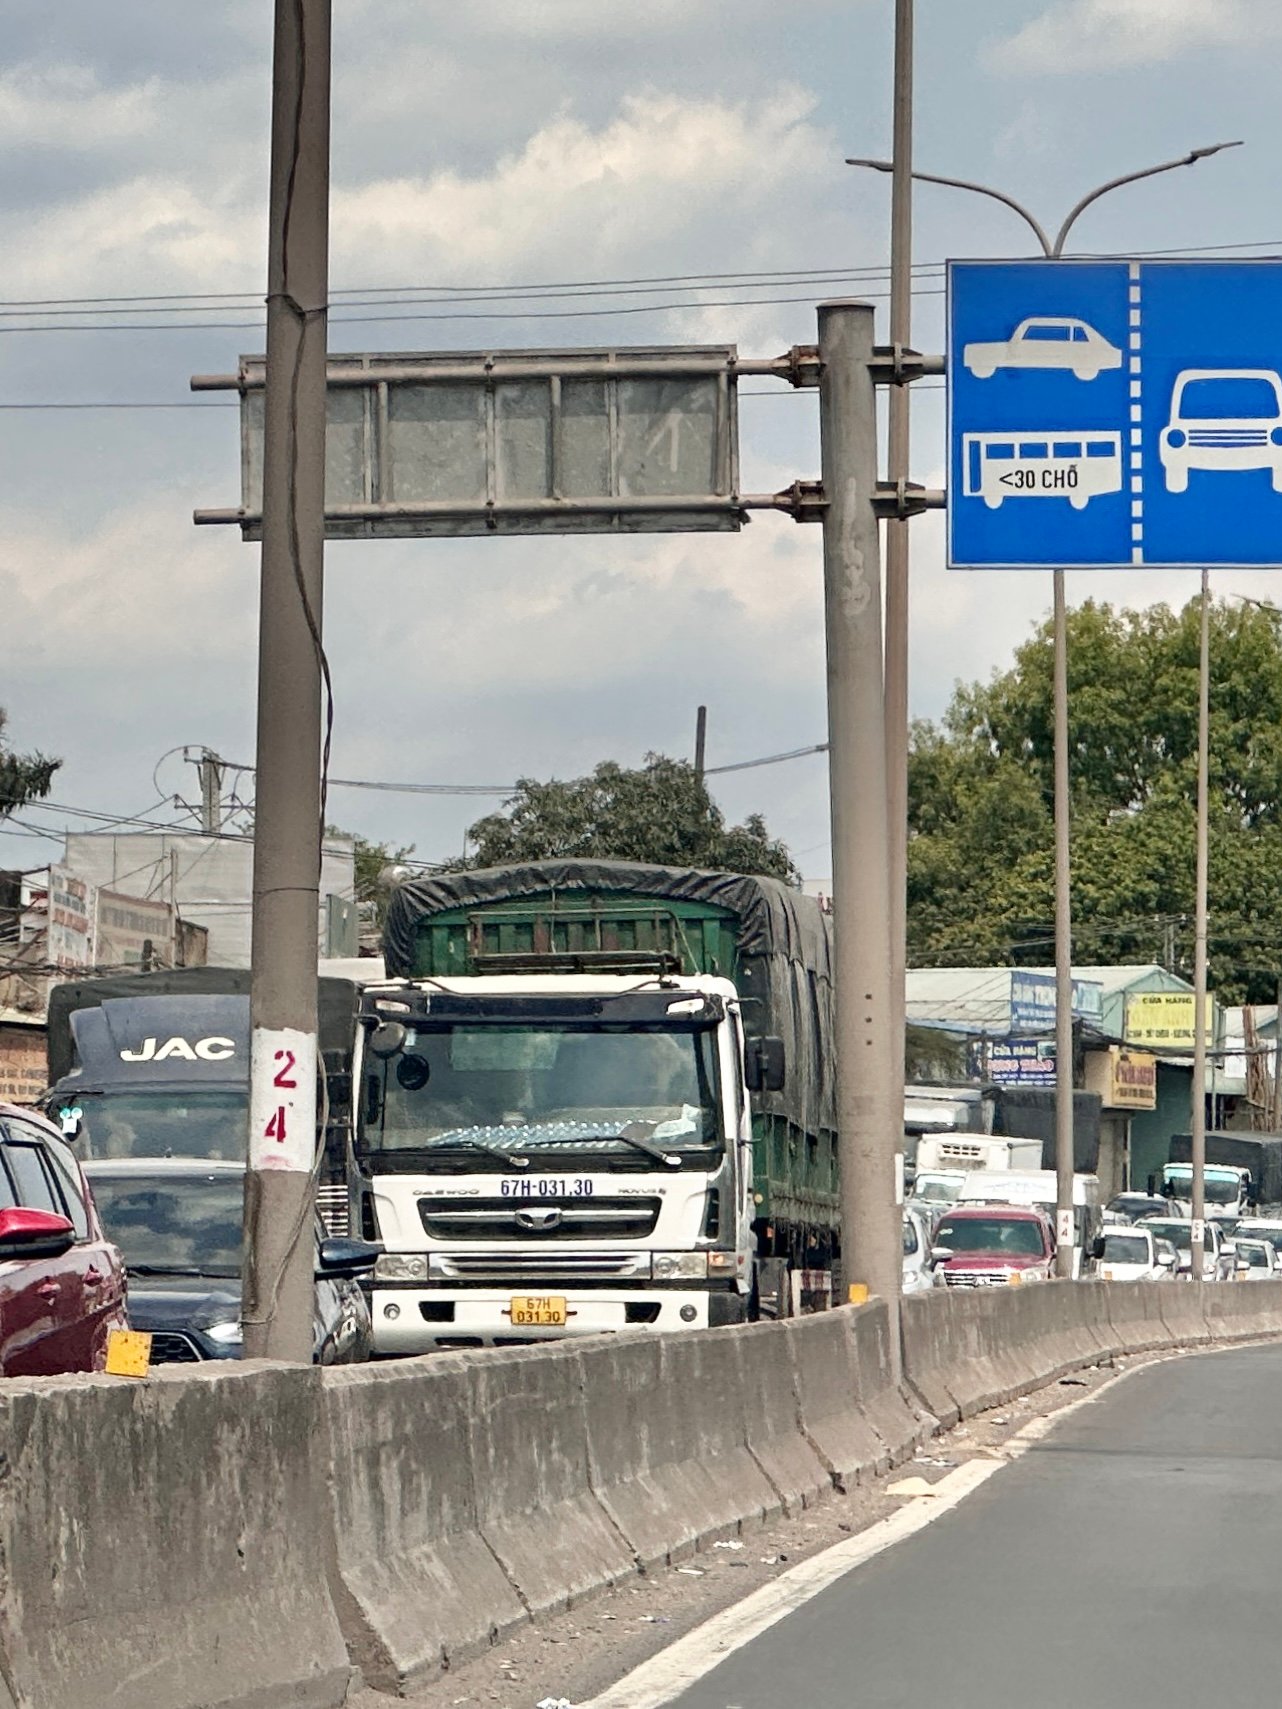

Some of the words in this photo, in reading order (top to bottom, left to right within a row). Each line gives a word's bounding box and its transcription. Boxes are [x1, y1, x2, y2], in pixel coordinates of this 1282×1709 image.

[999, 470, 1035, 488] <30
[1042, 464, 1078, 488] CHỖ
[120, 1036, 236, 1062] JAC
[273, 1049, 297, 1089] 2
[264, 1105, 287, 1143] 4
[500, 1179, 593, 1197] 67H-031.30
[527, 1298, 551, 1310] 67H
